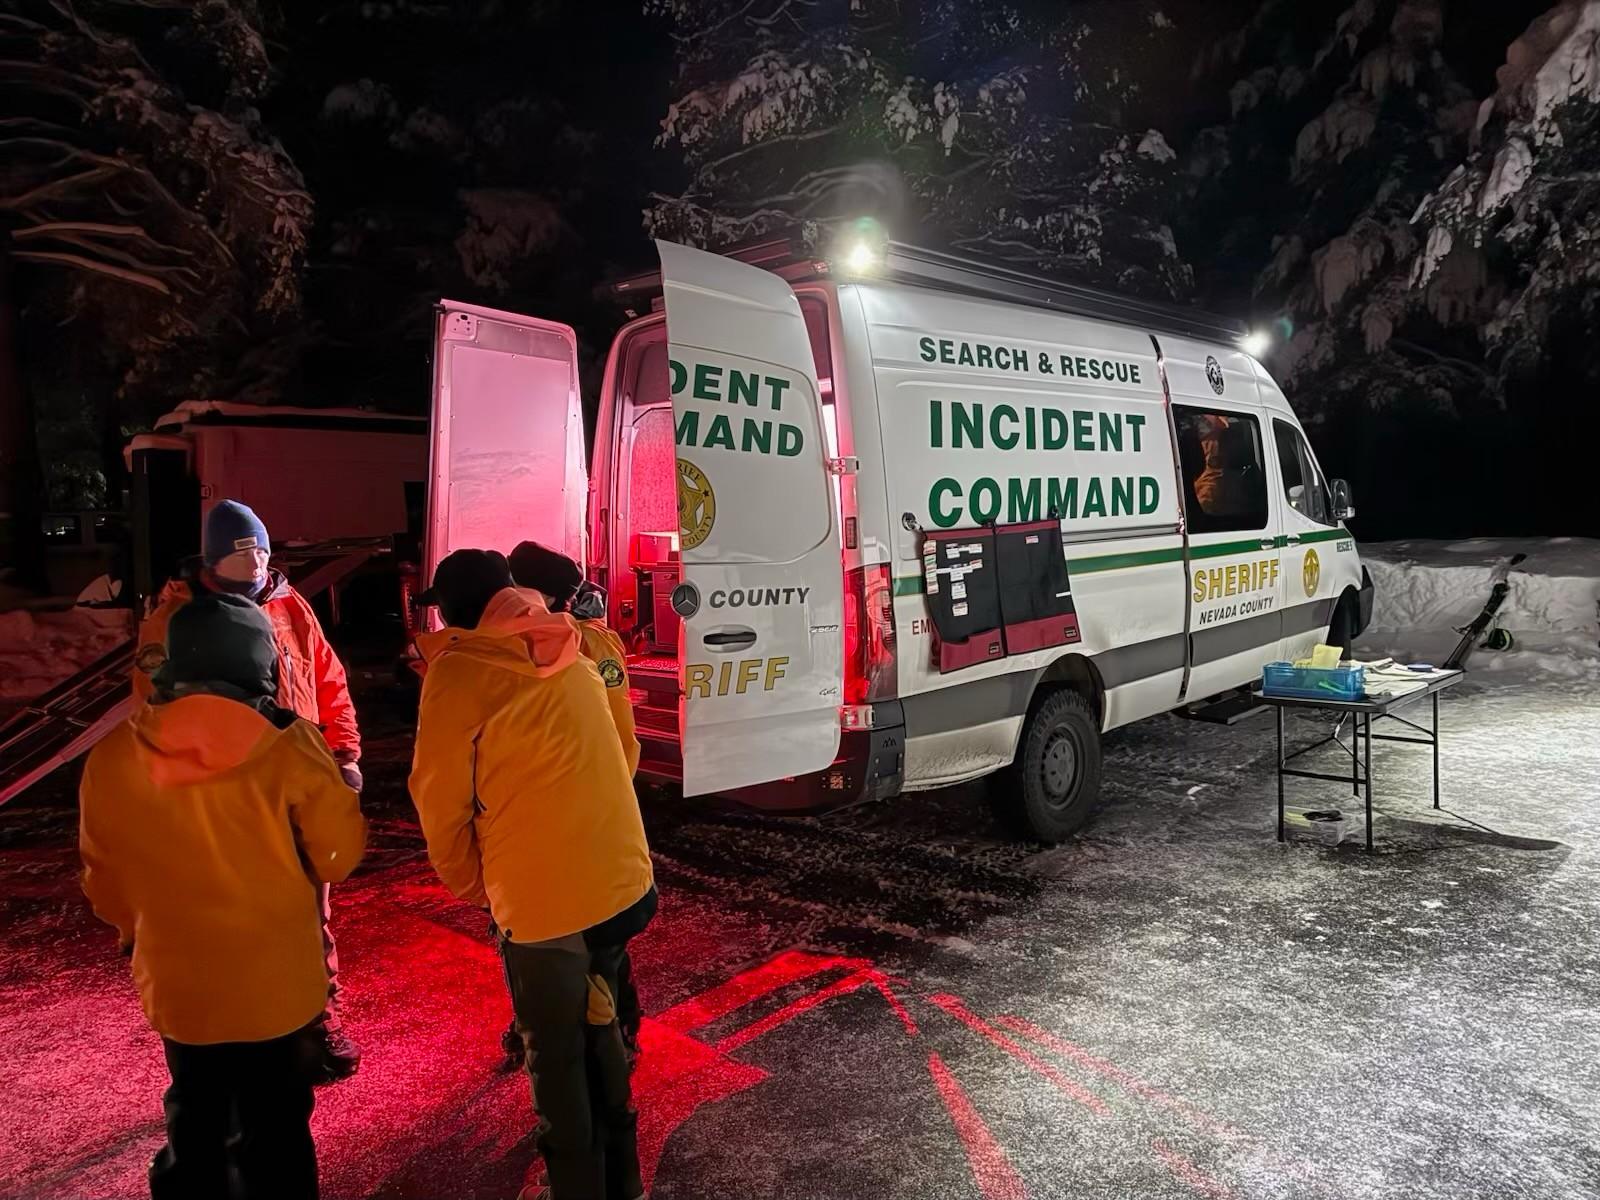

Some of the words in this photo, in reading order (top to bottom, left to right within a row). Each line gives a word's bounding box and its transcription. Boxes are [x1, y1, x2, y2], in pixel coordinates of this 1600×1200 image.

[919, 336, 1029, 372] SEARCH
[1038, 352, 1054, 375] &
[1060, 355, 1142, 384] RESCUE
[930, 400, 1146, 453] INCIDENT
[928, 476, 1160, 528] COMMAND
[709, 587, 810, 609] COUNTY
[1193, 558, 1279, 603] SHERIFF
[1200, 606, 1237, 625] NEVADA
[1239, 596, 1274, 616] COUNTY
[685, 656, 789, 700] RIFF
